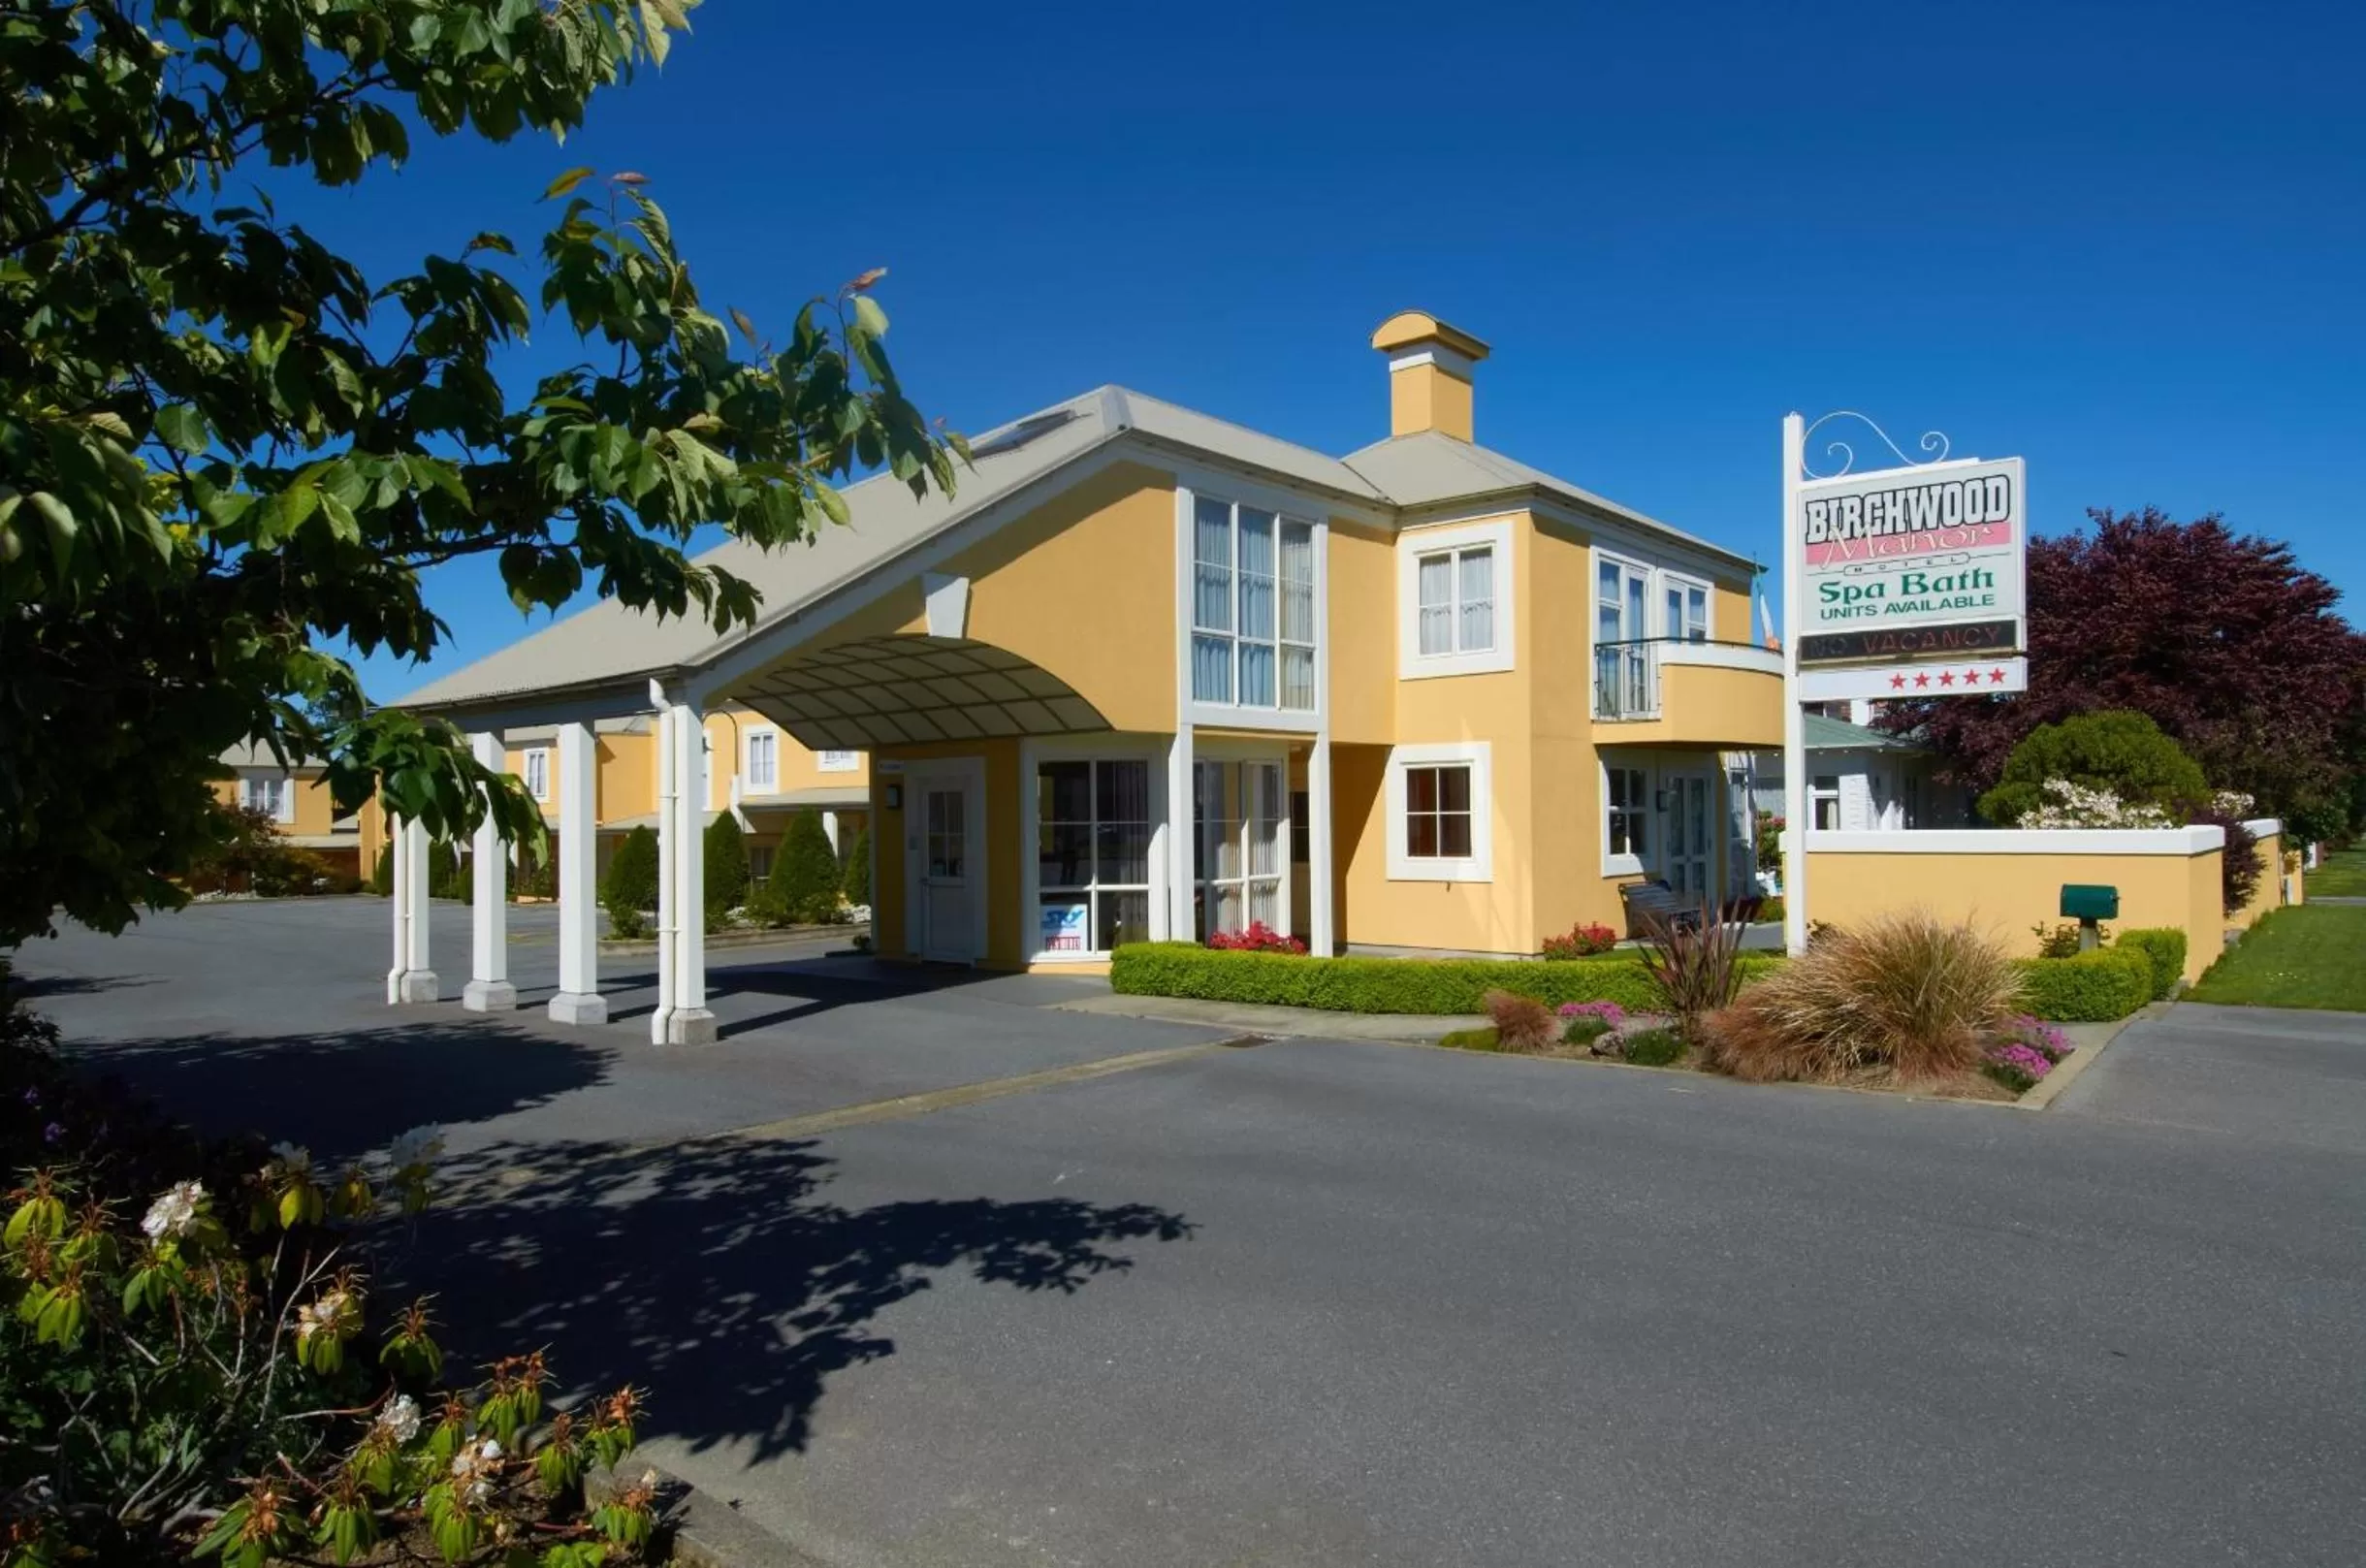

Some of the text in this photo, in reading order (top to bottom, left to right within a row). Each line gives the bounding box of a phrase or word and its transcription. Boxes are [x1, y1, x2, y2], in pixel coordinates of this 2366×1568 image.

[1806, 474, 2011, 546] BIRCHWOOD
[1819, 522, 1993, 570] Manor
[1853, 557, 1957, 573] MOTEL
[1818, 566, 1995, 605] Spa Bath
[1820, 593, 1996, 621] UNITS AVAILABLE
[1809, 624, 2002, 656] NO VACANCY
